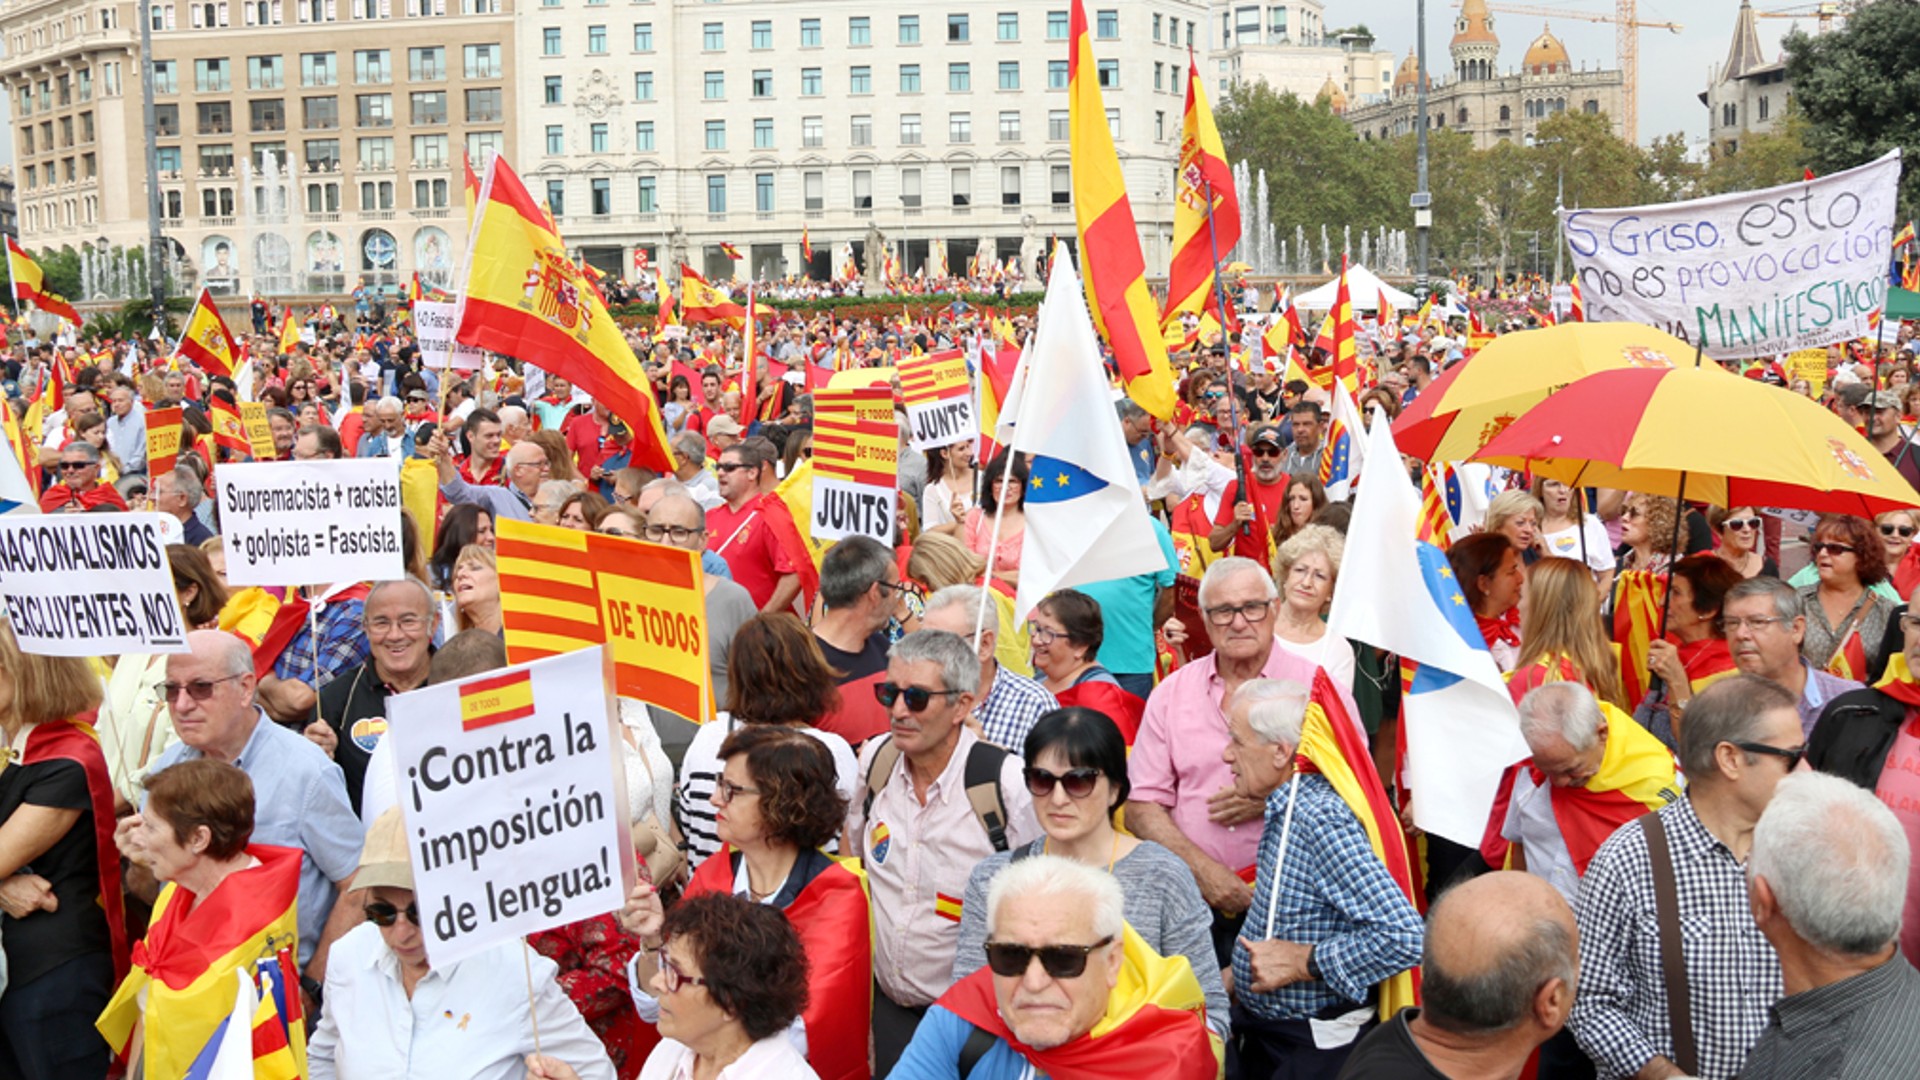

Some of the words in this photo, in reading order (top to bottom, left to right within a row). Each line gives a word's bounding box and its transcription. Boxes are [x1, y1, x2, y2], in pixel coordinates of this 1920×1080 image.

[1737, 186, 1861, 246] esto
[1580, 265, 1622, 297] no
[1632, 266, 1666, 298] es
[856, 409, 865, 419] DE
[869, 409, 894, 420] TODOS
[917, 402, 969, 441] JUNTS
[856, 445, 867, 458] DE
[870, 447, 897, 463] TODOS
[226, 480, 330, 519] Supremacista
[334, 484, 342, 503] +
[347, 479, 397, 508] racista
[817, 488, 888, 537] JUNTS
[0, 523, 161, 572] NACIONALISMOS
[232, 533, 241, 552] +
[246, 528, 310, 565] golpista
[315, 534, 324, 548] =
[329, 524, 399, 554] Fascista.
[4, 593, 145, 644] EXCLUYENTES,
[140, 592, 180, 637] NO!
[607, 599, 636, 640] DE
[636, 604, 700, 657] TODOS
[470, 702, 478, 712] DE
[480, 697, 500, 709] TODOS
[408, 735, 555, 812] ¡Contra
[563, 713, 596, 756] la
[418, 785, 604, 871] imposición
[434, 895, 477, 941] de
[486, 846, 611, 922] lengua!
